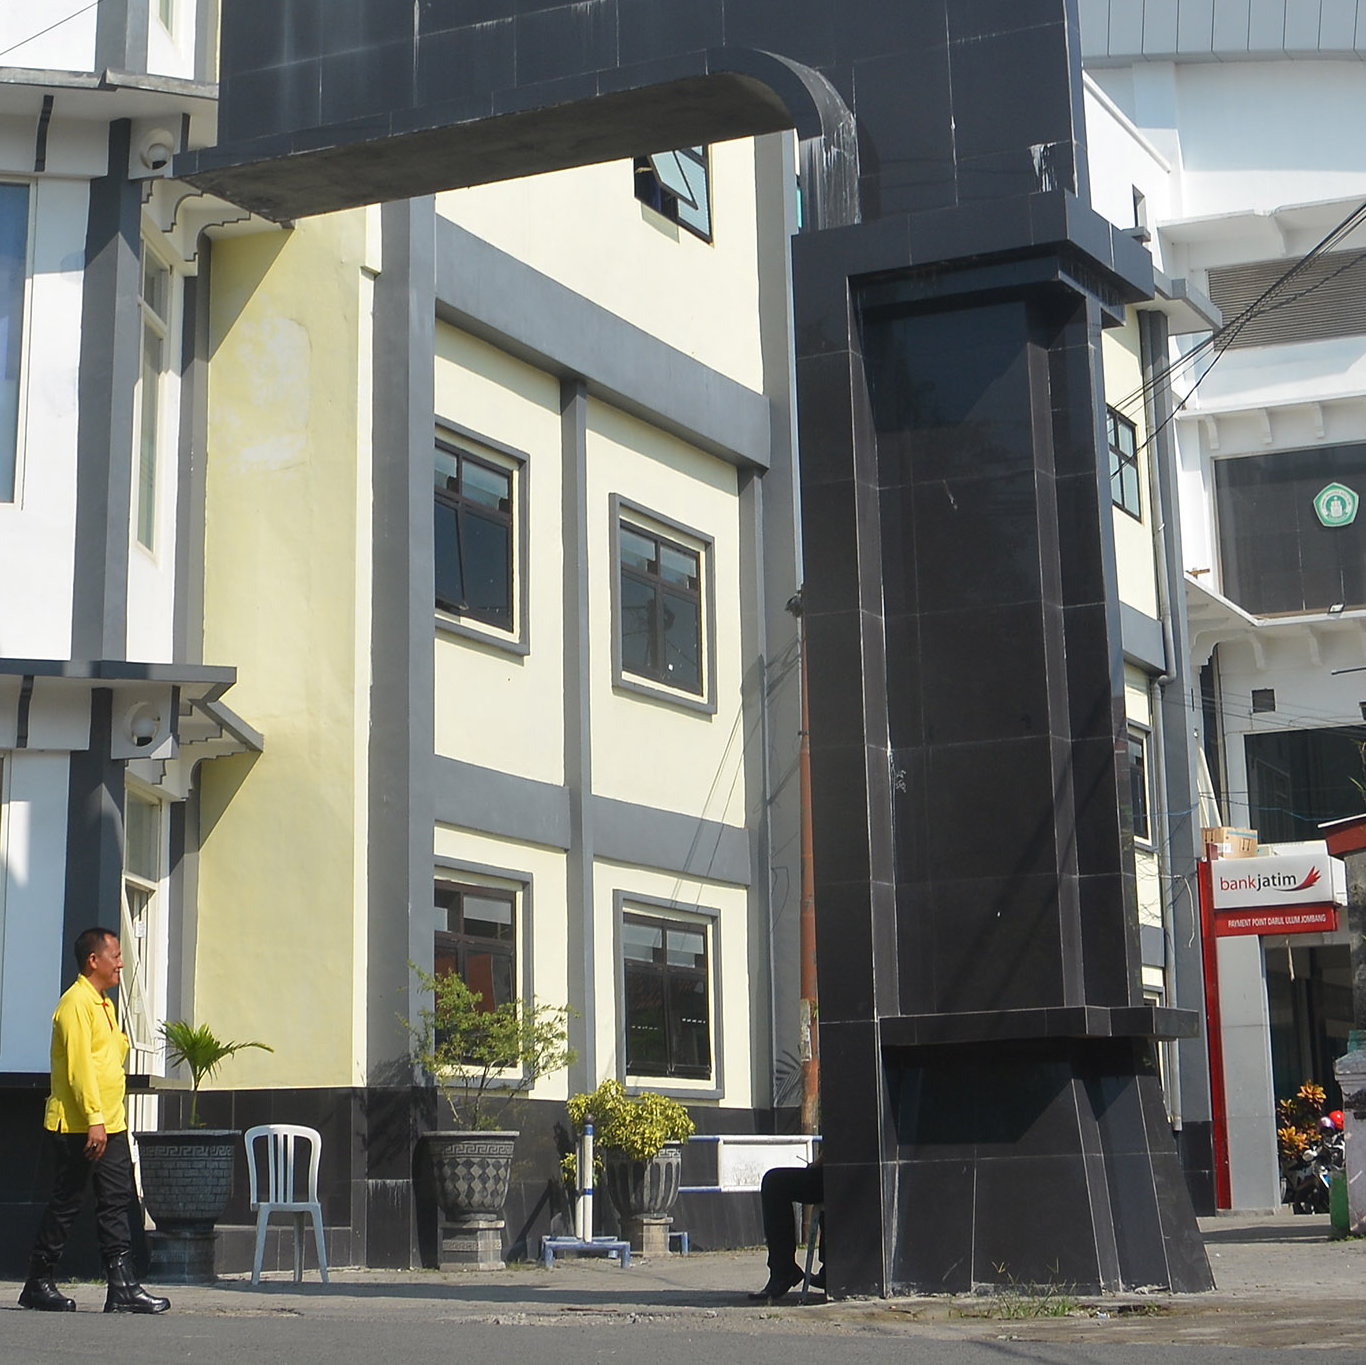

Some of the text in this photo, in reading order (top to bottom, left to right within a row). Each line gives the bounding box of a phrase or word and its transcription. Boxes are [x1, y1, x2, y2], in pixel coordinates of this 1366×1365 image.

[1228, 914, 1326, 928] PAYMENT POINT DARUL ULUM JOMBANG
